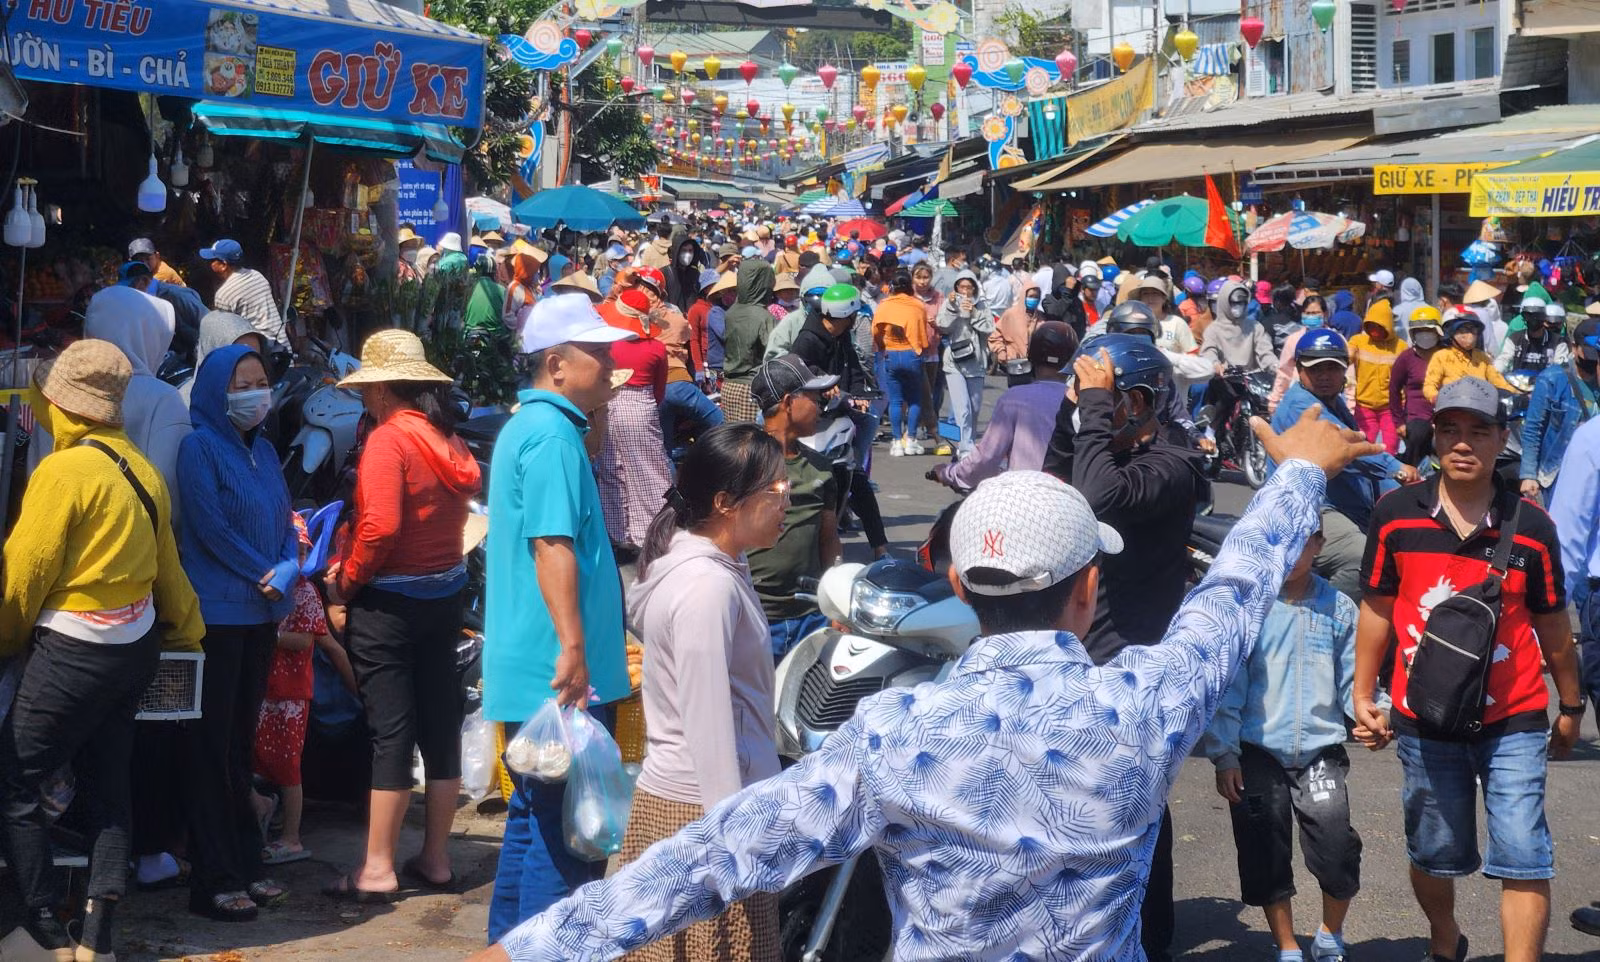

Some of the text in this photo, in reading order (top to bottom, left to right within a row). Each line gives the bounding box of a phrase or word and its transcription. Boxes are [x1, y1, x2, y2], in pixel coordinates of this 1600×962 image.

[0, 32, 60, 71] ƯỜN
[87, 43, 114, 79] BÌ
[139, 50, 190, 88] CHẢ
[308, 41, 468, 119] GIỮ XE
[1413, 169, 1435, 188] XE
[1541, 175, 1580, 212] HIẾU
[982, 528, 1005, 558] NY
